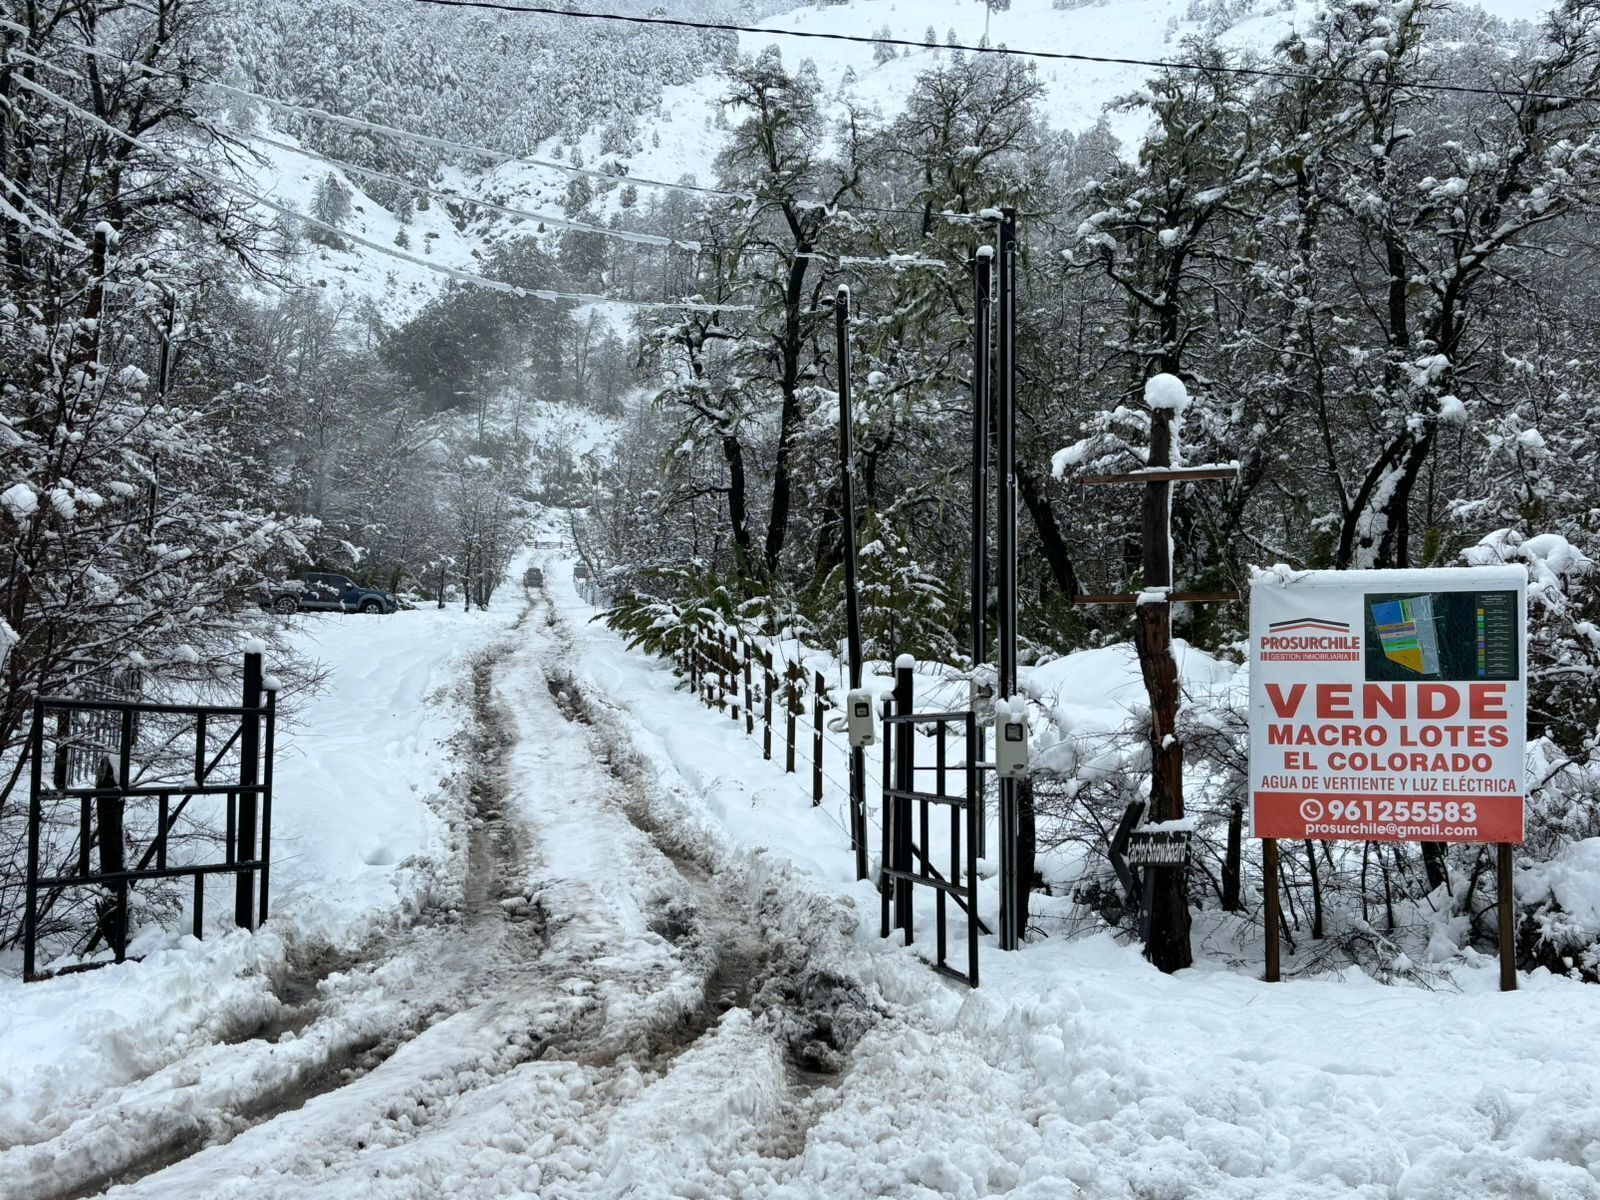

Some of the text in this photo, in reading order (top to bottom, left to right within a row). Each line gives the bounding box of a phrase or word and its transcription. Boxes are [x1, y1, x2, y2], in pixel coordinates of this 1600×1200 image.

[1260, 637, 1360, 650] PROSURCHILE
[1265, 683, 1507, 720] VENDE
[1268, 725, 1508, 747] MACRO LOTES
[1284, 752, 1492, 772] EL COLORADO
[1261, 775, 1516, 792] AGUA DE VERTIENTE Y LUZ ELÉCTRICA
[1328, 801, 1476, 822] 961255583
[1305, 822, 1477, 837] prosurchile@gmail.com
